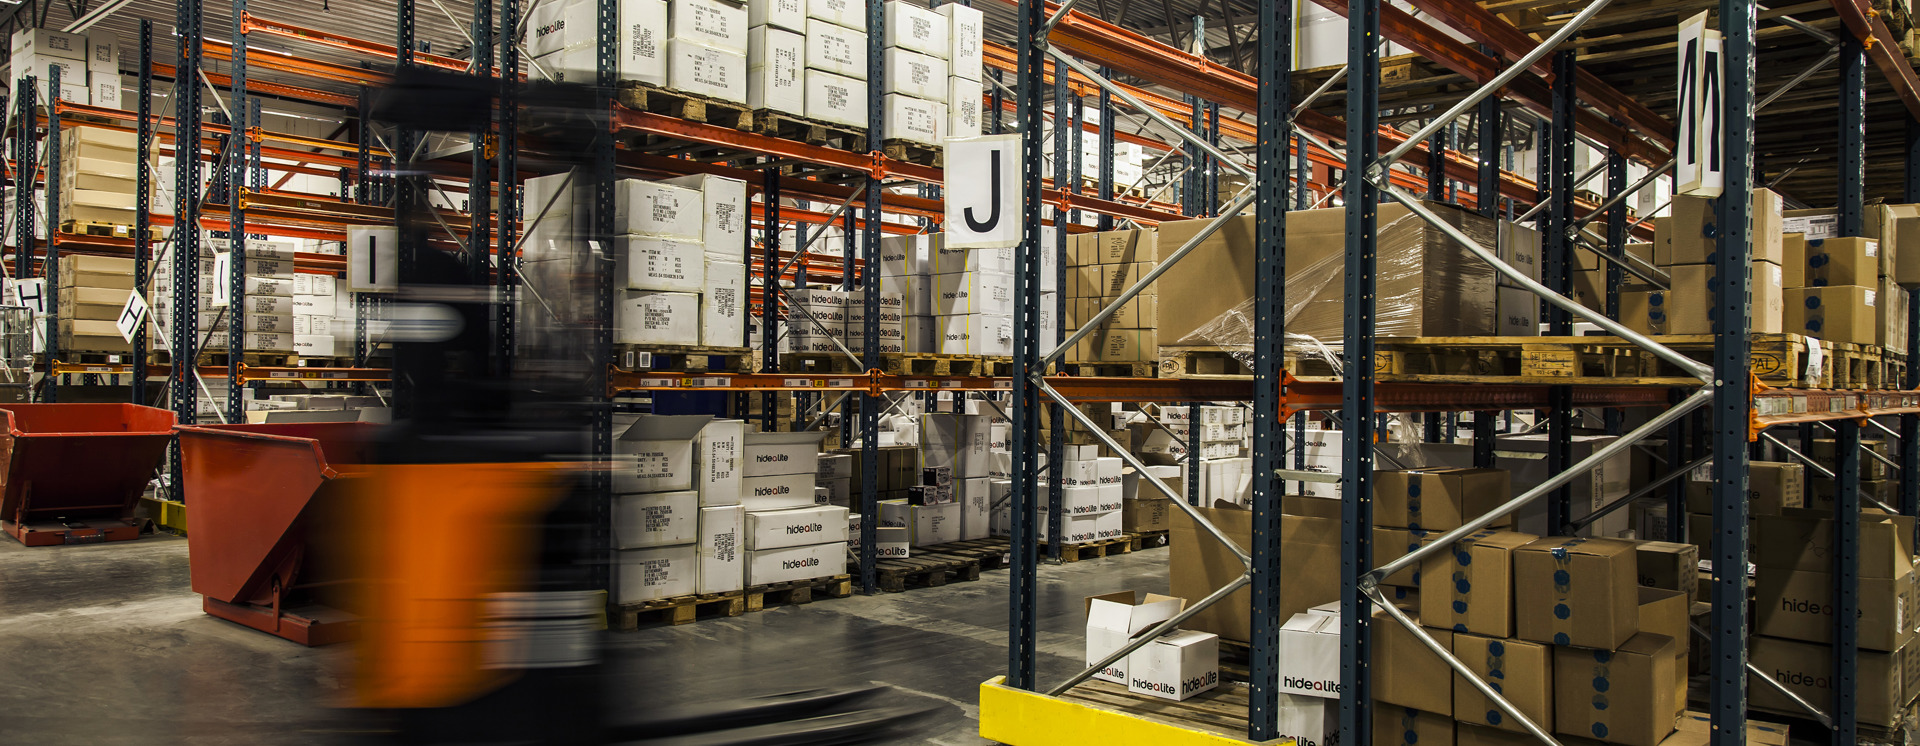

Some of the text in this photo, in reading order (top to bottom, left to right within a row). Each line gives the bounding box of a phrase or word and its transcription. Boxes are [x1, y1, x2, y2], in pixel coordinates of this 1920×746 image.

[536, 20, 564, 38] hidealite
[964, 150, 1000, 233] J
[369, 236, 376, 284] I
[18, 283, 43, 312] H
[812, 294, 842, 304] hidealite
[880, 297, 900, 306] dealite
[121, 296, 143, 335] H
[812, 310, 843, 320] hidealite
[880, 313, 900, 321] dealite
[880, 328, 900, 337] dealite
[880, 344, 900, 352] dealite
[1751, 358, 1773, 369] PAL
[756, 454, 788, 463] hidealite
[1100, 476, 1121, 484] hidealite
[755, 486, 789, 496] hidealite
[1074, 505, 1097, 513] hidealite
[1100, 502, 1121, 511] hidealite
[787, 523, 822, 534] hidealite
[1098, 529, 1121, 538] hidealite
[1072, 533, 1095, 541] hidealite
[783, 557, 819, 570] hidealite
[1133, 678, 1175, 694] hidealite
[1182, 671, 1216, 694] hidealite
[1284, 676, 1340, 693] hidealite
